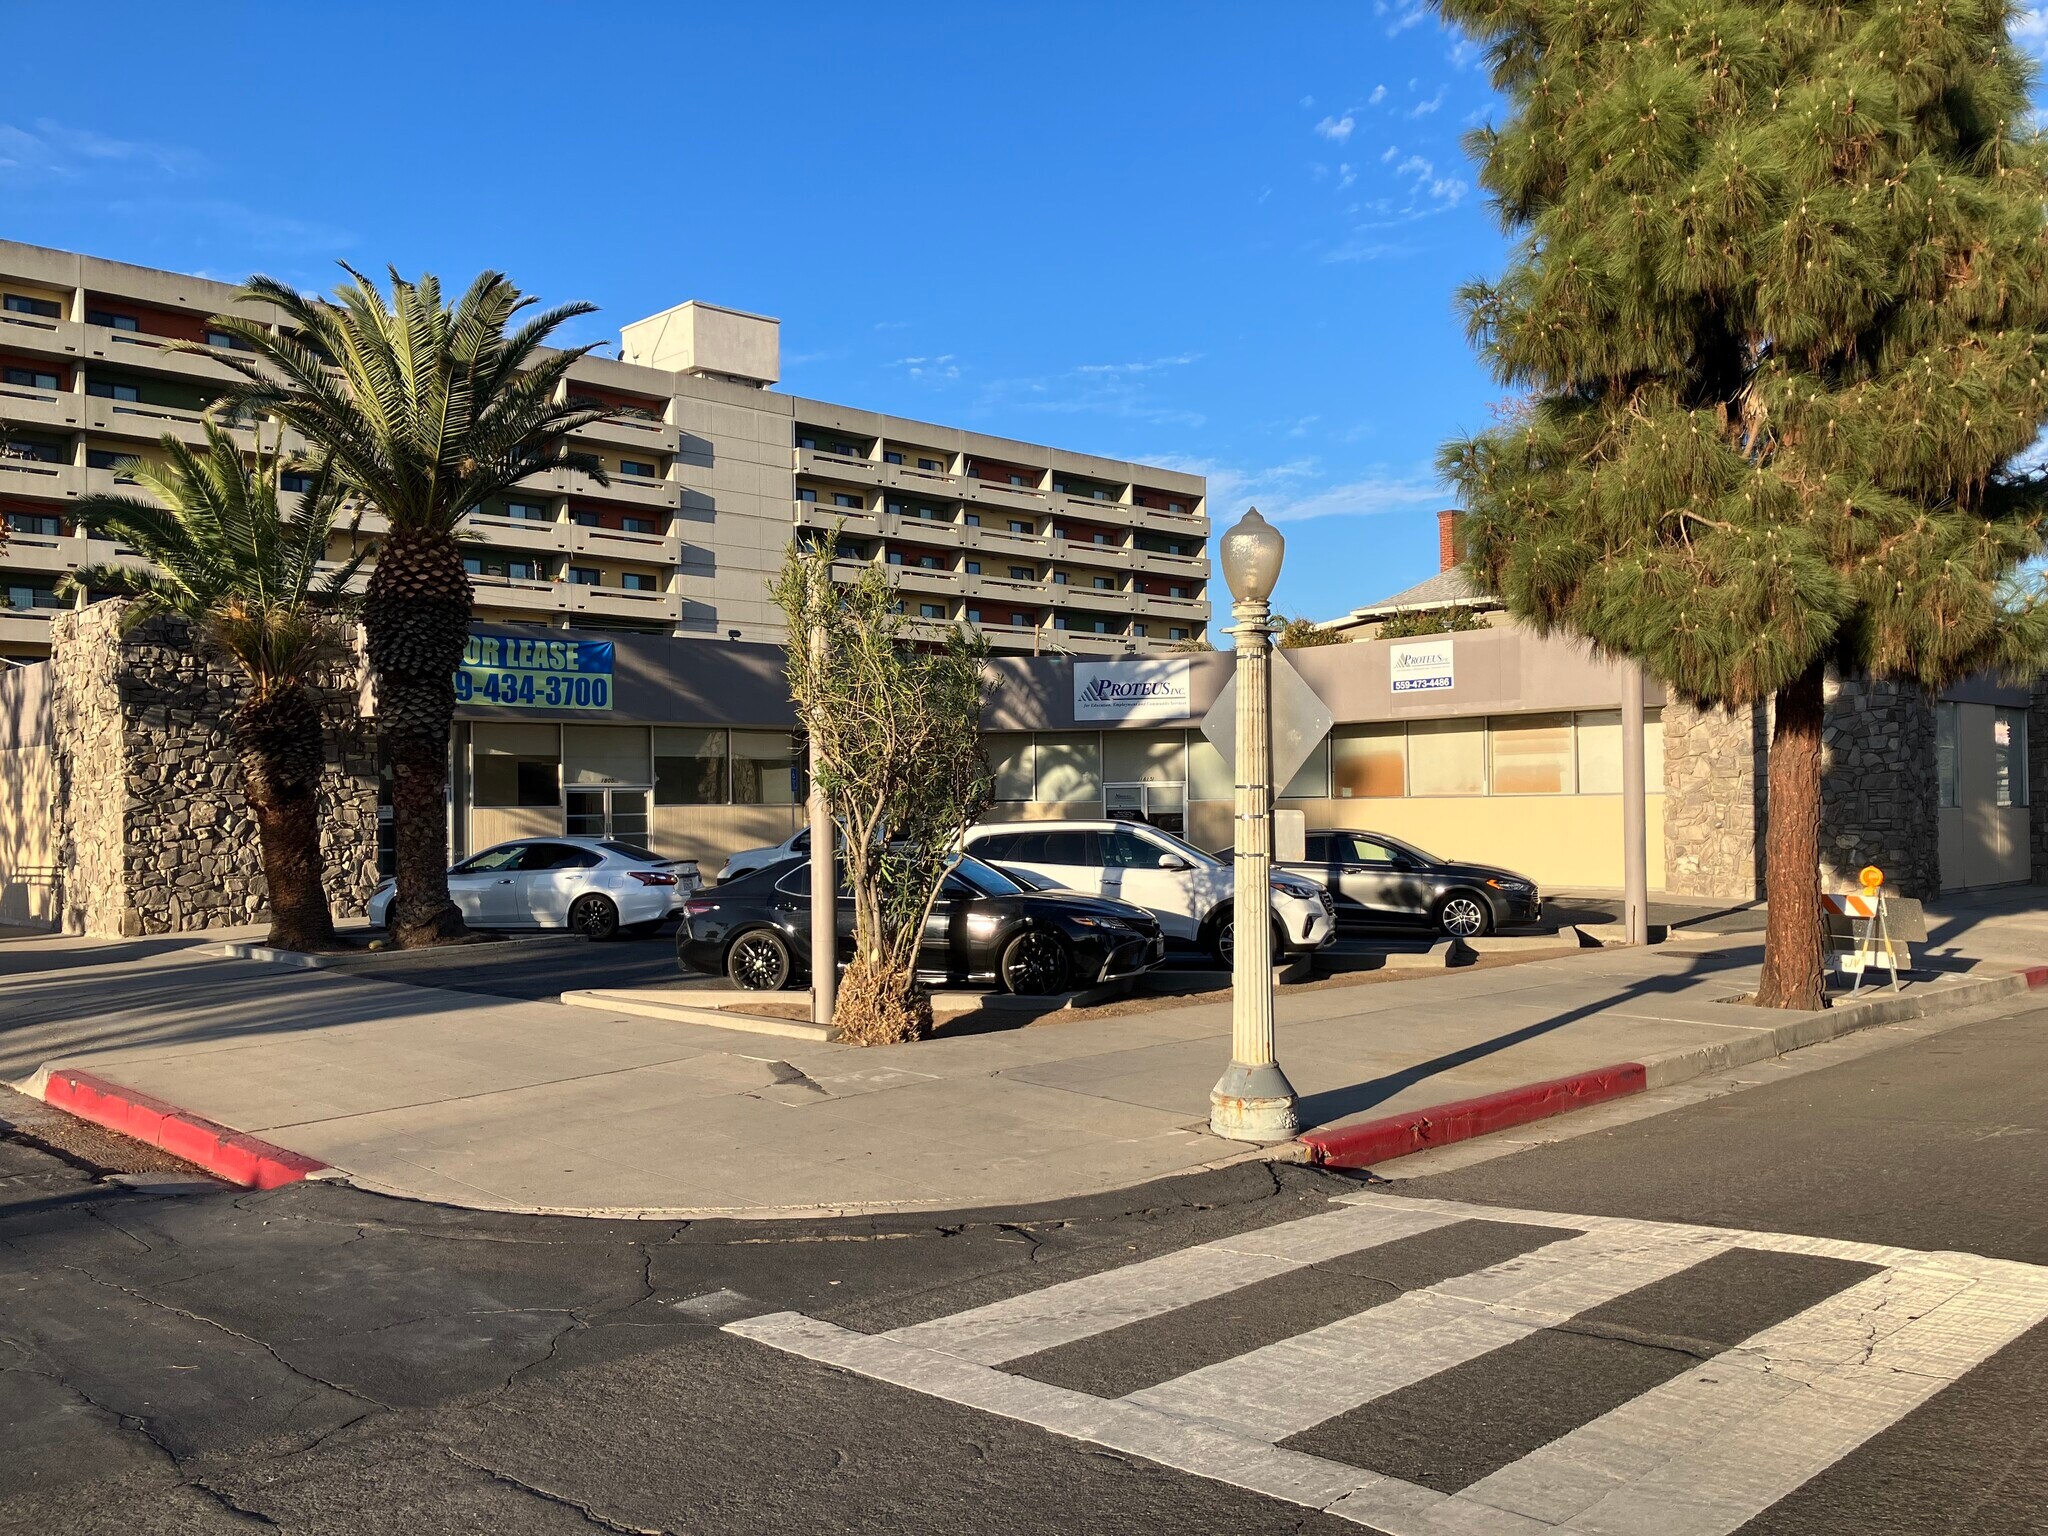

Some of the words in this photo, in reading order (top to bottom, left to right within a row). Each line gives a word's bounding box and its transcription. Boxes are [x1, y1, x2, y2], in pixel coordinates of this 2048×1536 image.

[463, 635, 499, 666] OR
[506, 638, 579, 671] LEASE
[1404, 654, 1442, 665] PROTEUS
[455, 671, 608, 707] 9-434-3700
[1096, 679, 1170, 697] PROTEUS
[1395, 677, 1450, 690] 559-473-4486
